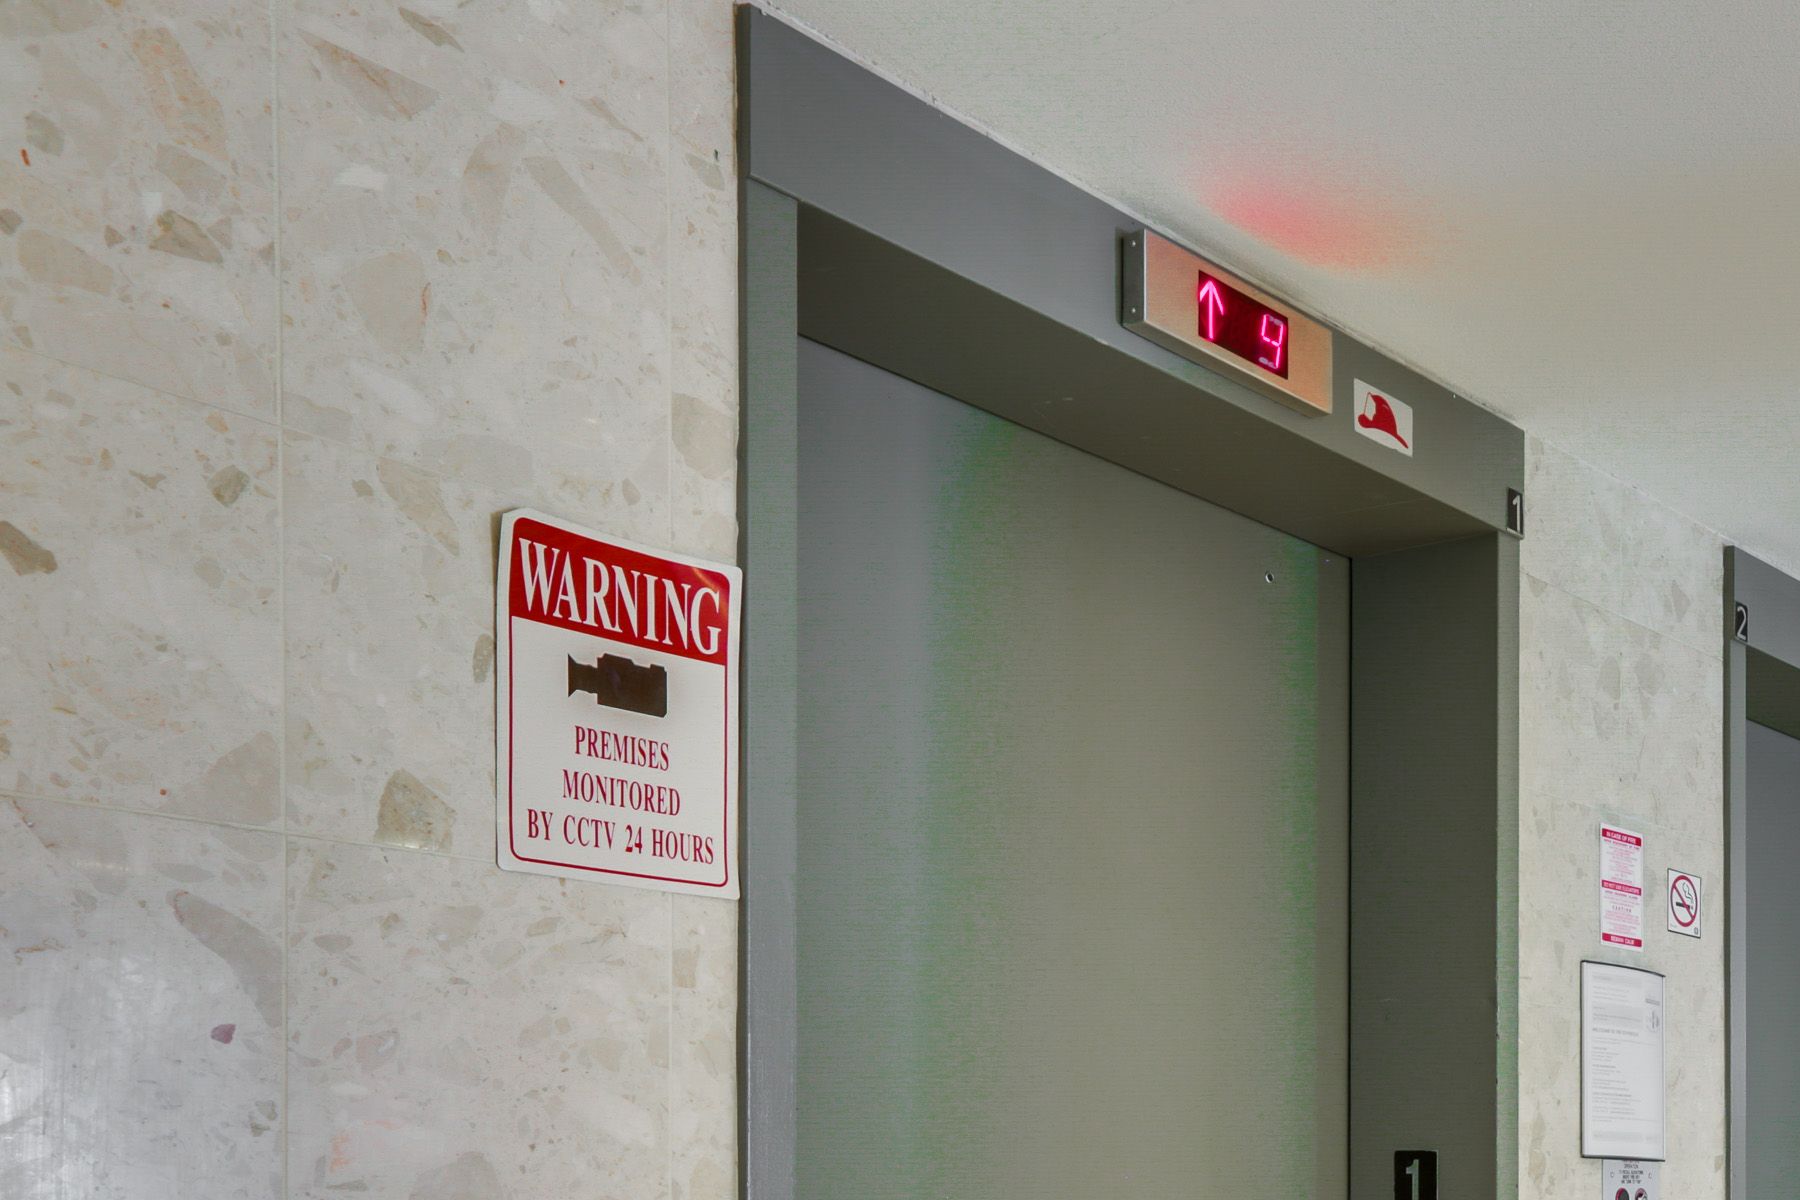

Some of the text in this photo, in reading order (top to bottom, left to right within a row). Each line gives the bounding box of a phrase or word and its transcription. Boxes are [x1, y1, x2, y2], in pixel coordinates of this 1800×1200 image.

[1259, 313, 1285, 370] 9
[1512, 494, 1521, 533] 1
[517, 536, 722, 657] WARNING
[1737, 606, 1747, 640] 2
[574, 725, 670, 771] PREMISES
[562, 769, 681, 816] MONITORED
[527, 808, 715, 866] BY CCTV 24 HOURS
